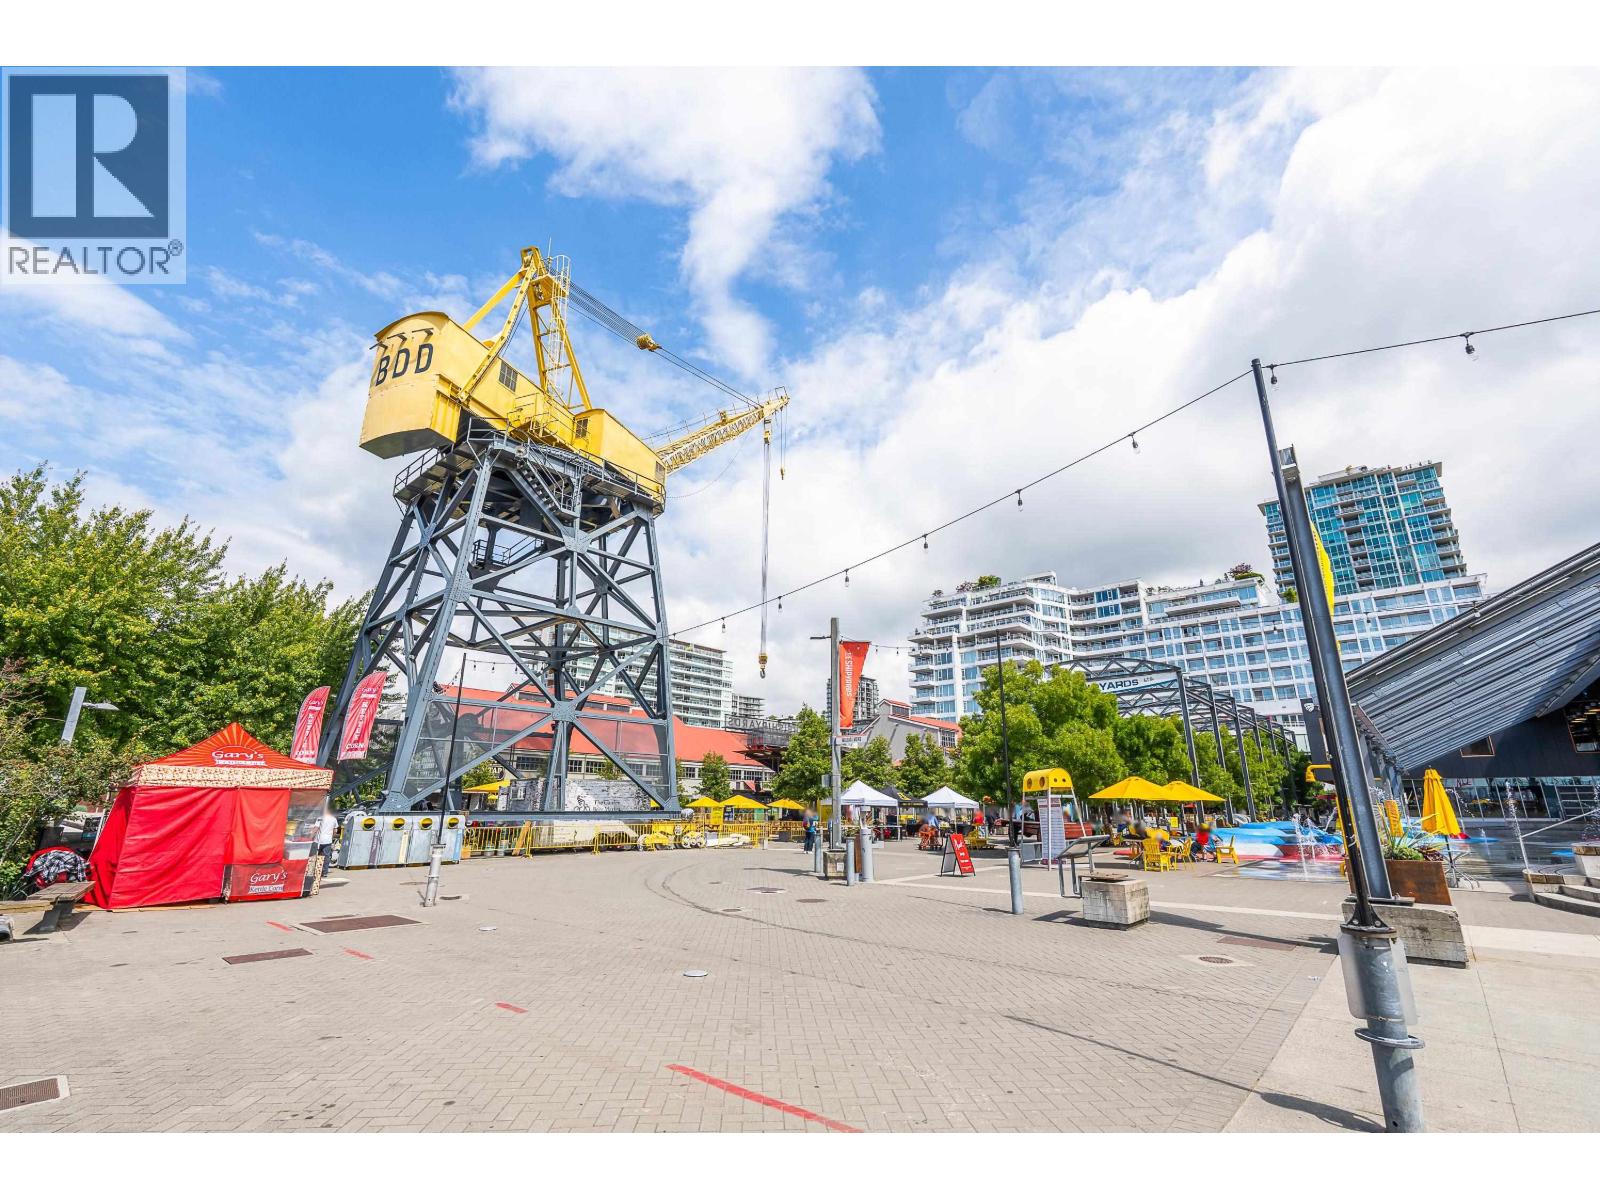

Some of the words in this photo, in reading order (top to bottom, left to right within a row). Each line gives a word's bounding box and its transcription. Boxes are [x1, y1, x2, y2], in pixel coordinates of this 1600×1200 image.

[375, 343, 434, 387] BDD
[1098, 679, 1139, 690] YARDS
[211, 750, 265, 762] Gary's
[249, 871, 288, 885] Gary's
